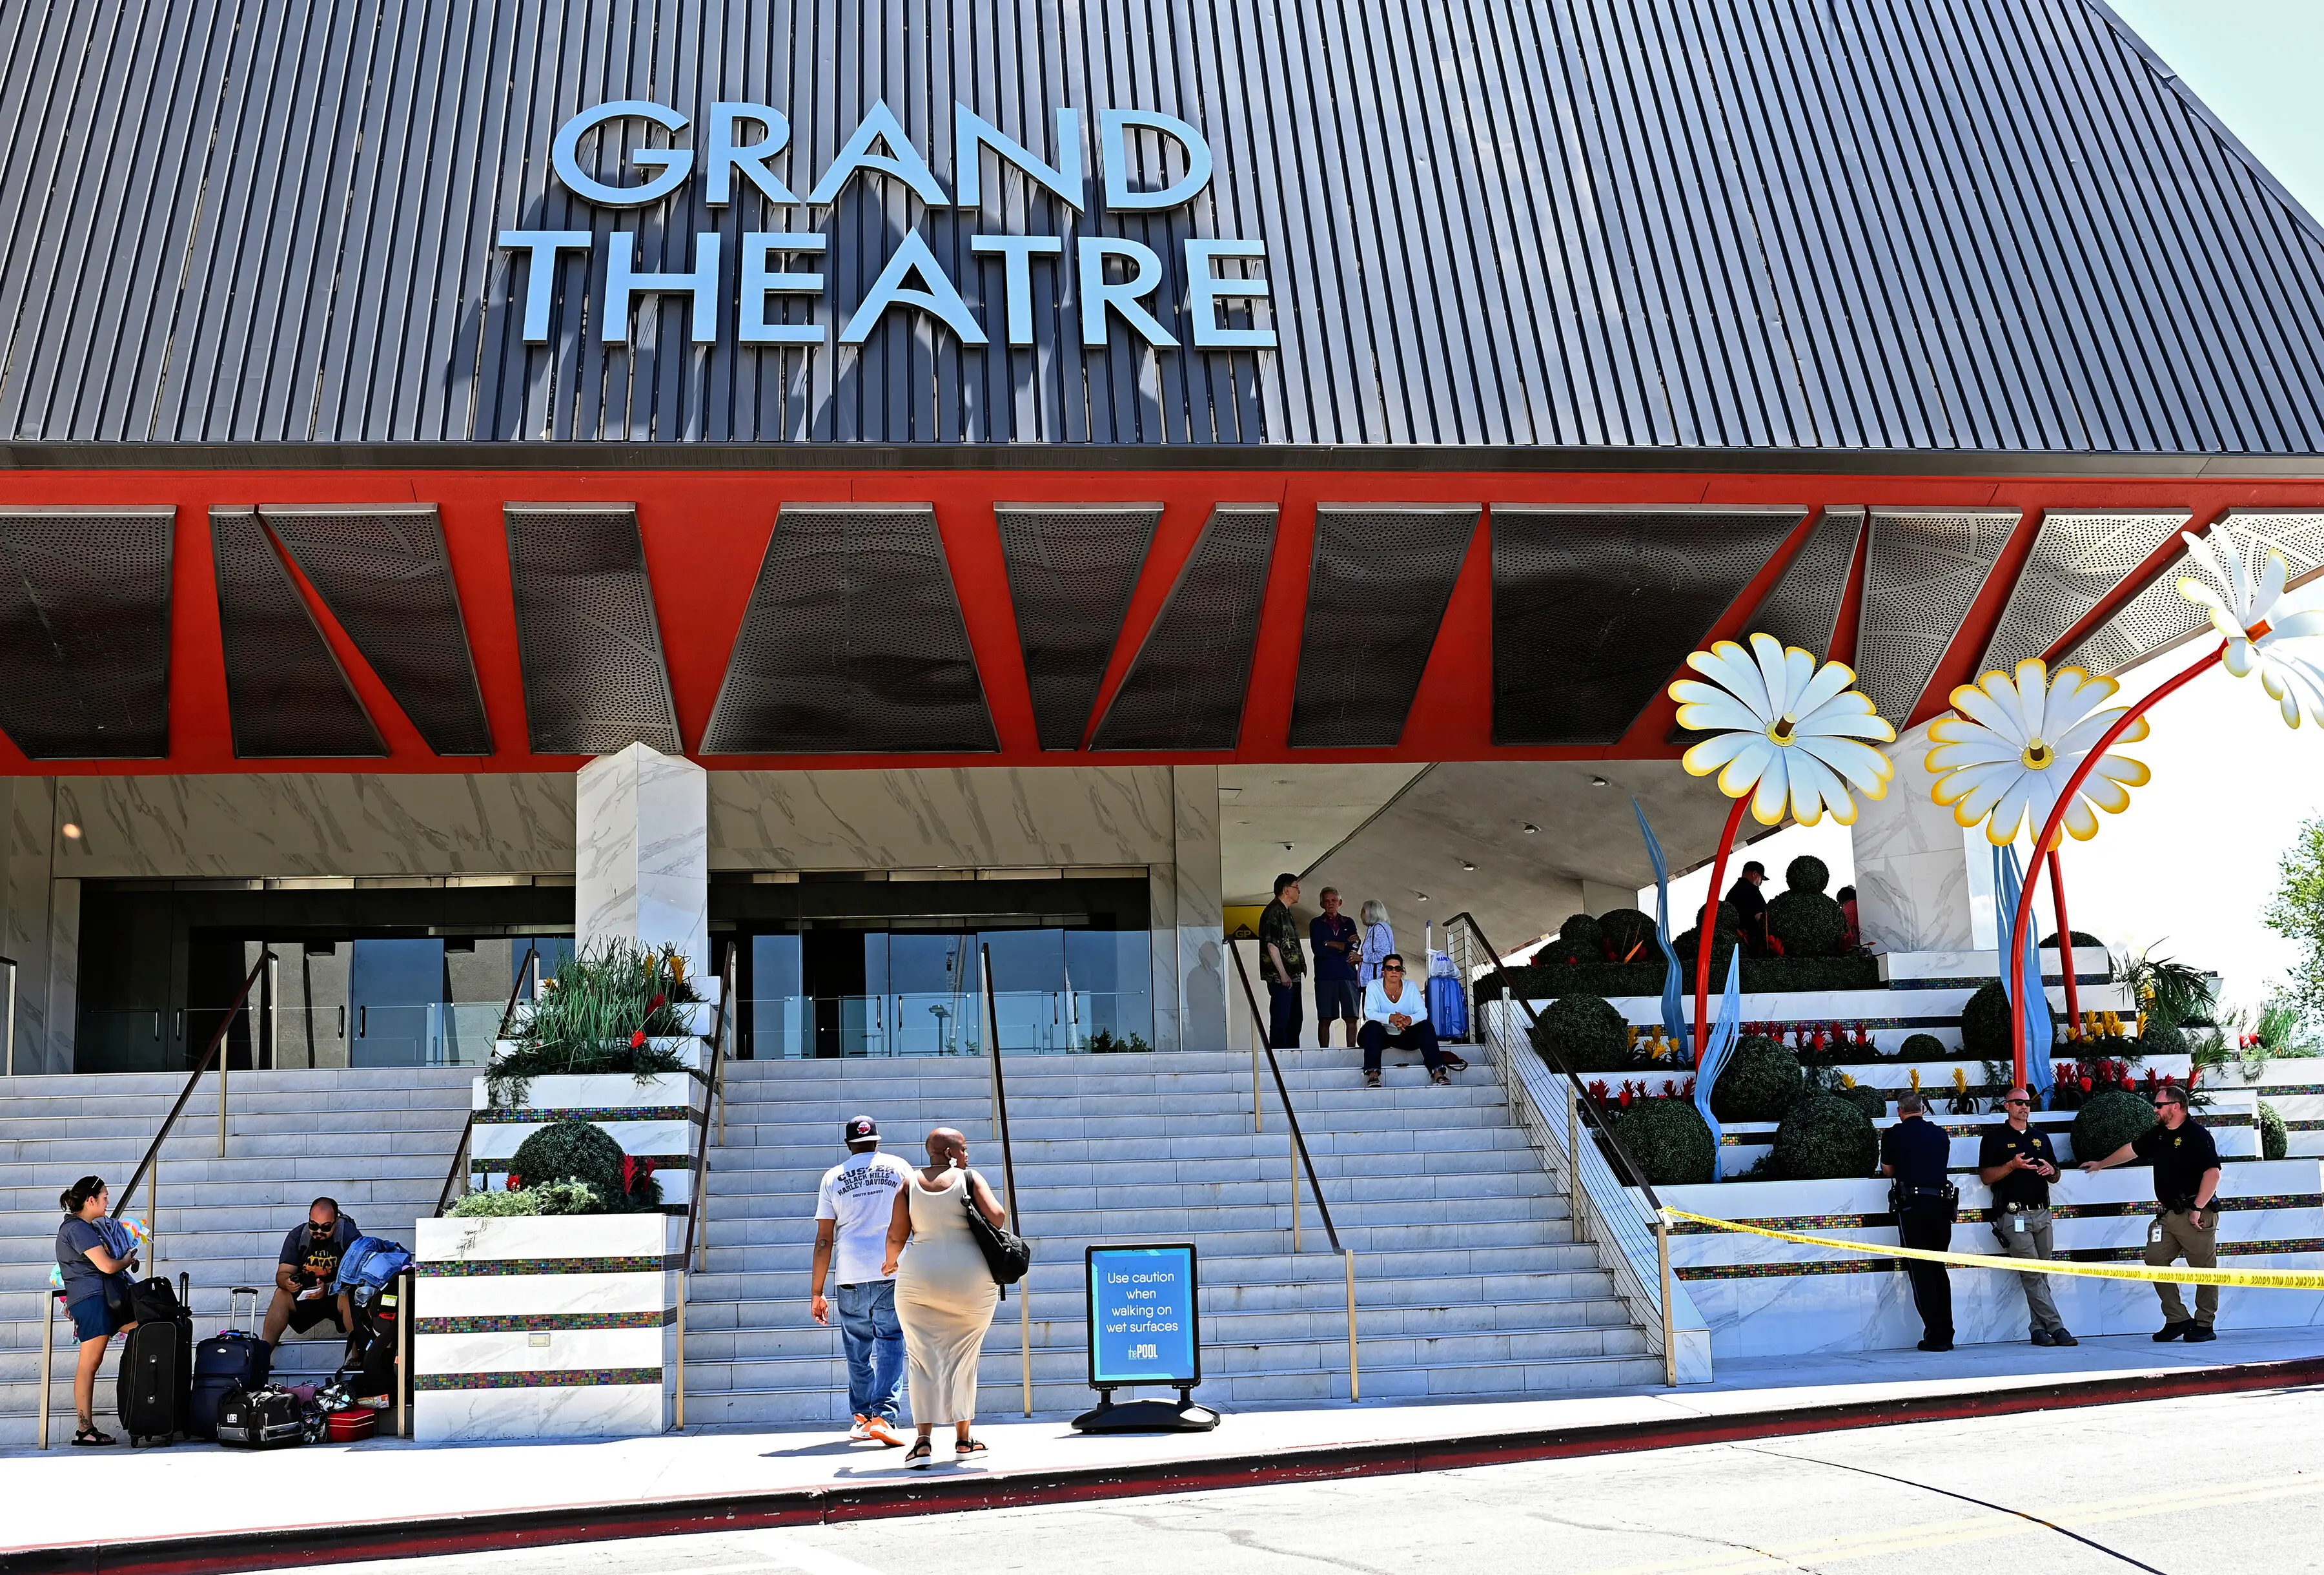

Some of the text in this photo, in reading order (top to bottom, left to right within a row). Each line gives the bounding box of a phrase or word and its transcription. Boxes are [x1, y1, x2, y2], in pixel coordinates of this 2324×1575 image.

[551, 98, 1214, 216] GRAND
[498, 227, 1277, 350] THEATRE
[844, 1174, 867, 1186] BLACK
[837, 1179, 898, 1196] HARLEY-DAVIDSON
[1108, 1272, 1174, 1284] Use caution
[1126, 1288, 1156, 1299] when
[1112, 1304, 1172, 1318] walking on
[1106, 1321, 1178, 1333] wet surfaces
